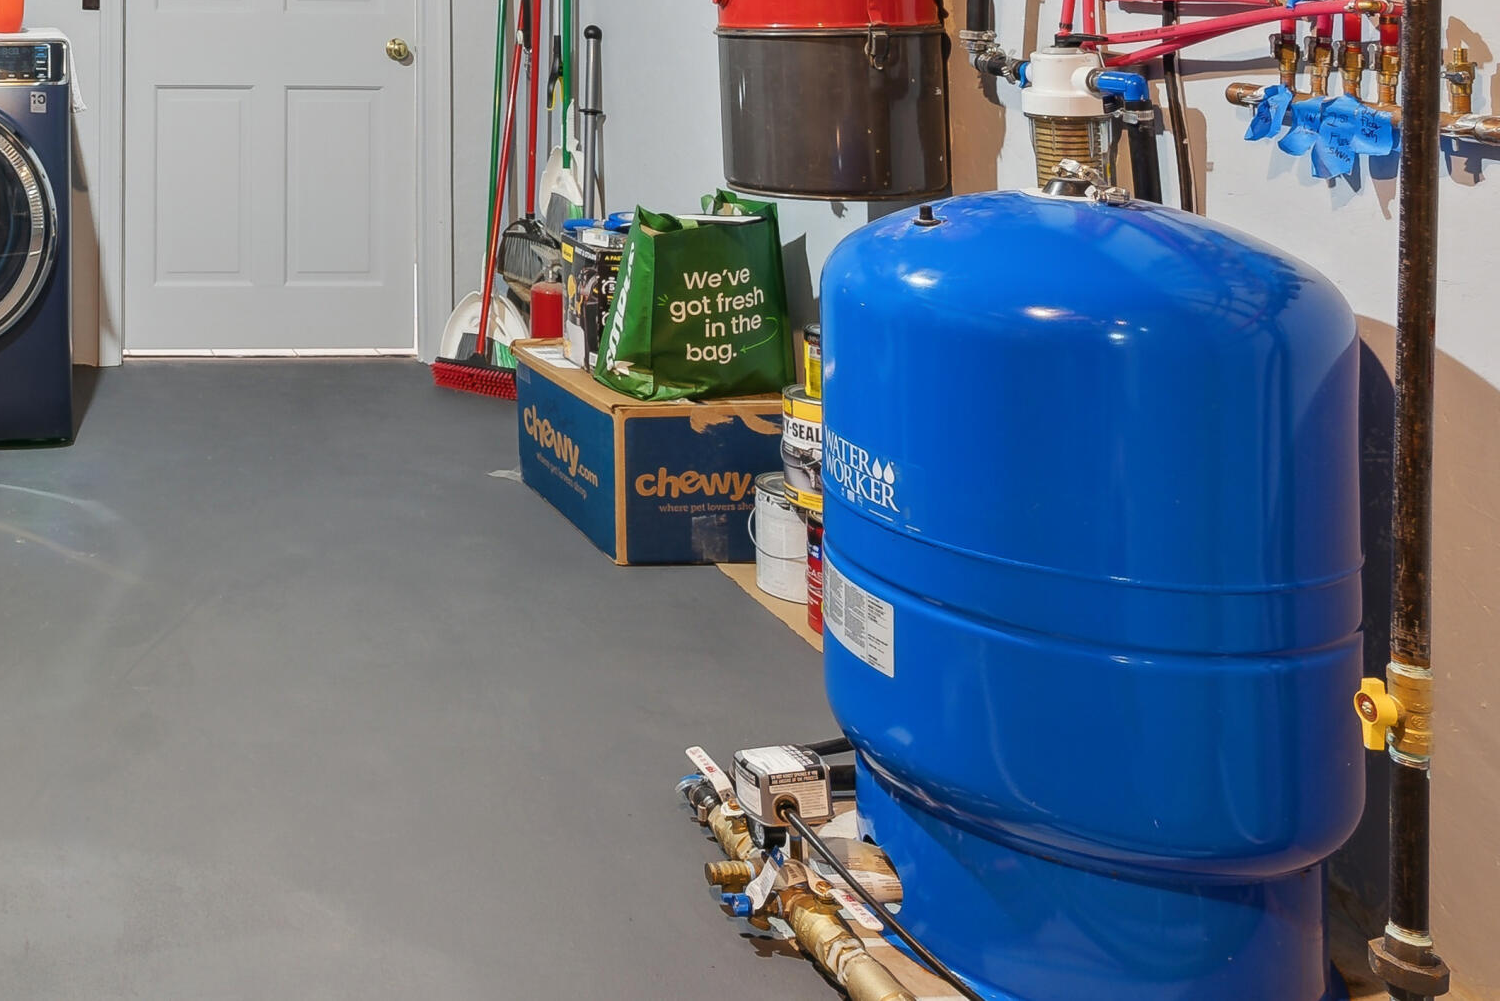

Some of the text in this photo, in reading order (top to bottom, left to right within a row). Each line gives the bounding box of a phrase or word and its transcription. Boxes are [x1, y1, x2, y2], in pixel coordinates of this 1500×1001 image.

[669, 286, 764, 323] got fresh
[704, 313, 762, 338] in the
[686, 343, 738, 365] bag.
[523, 402, 599, 488] chewy.com
[824, 424, 873, 478] WATER
[823, 451, 901, 513] WORKER
[659, 503, 688, 513] where
[690, 503, 706, 515] pet
[707, 502, 735, 513] lovers
